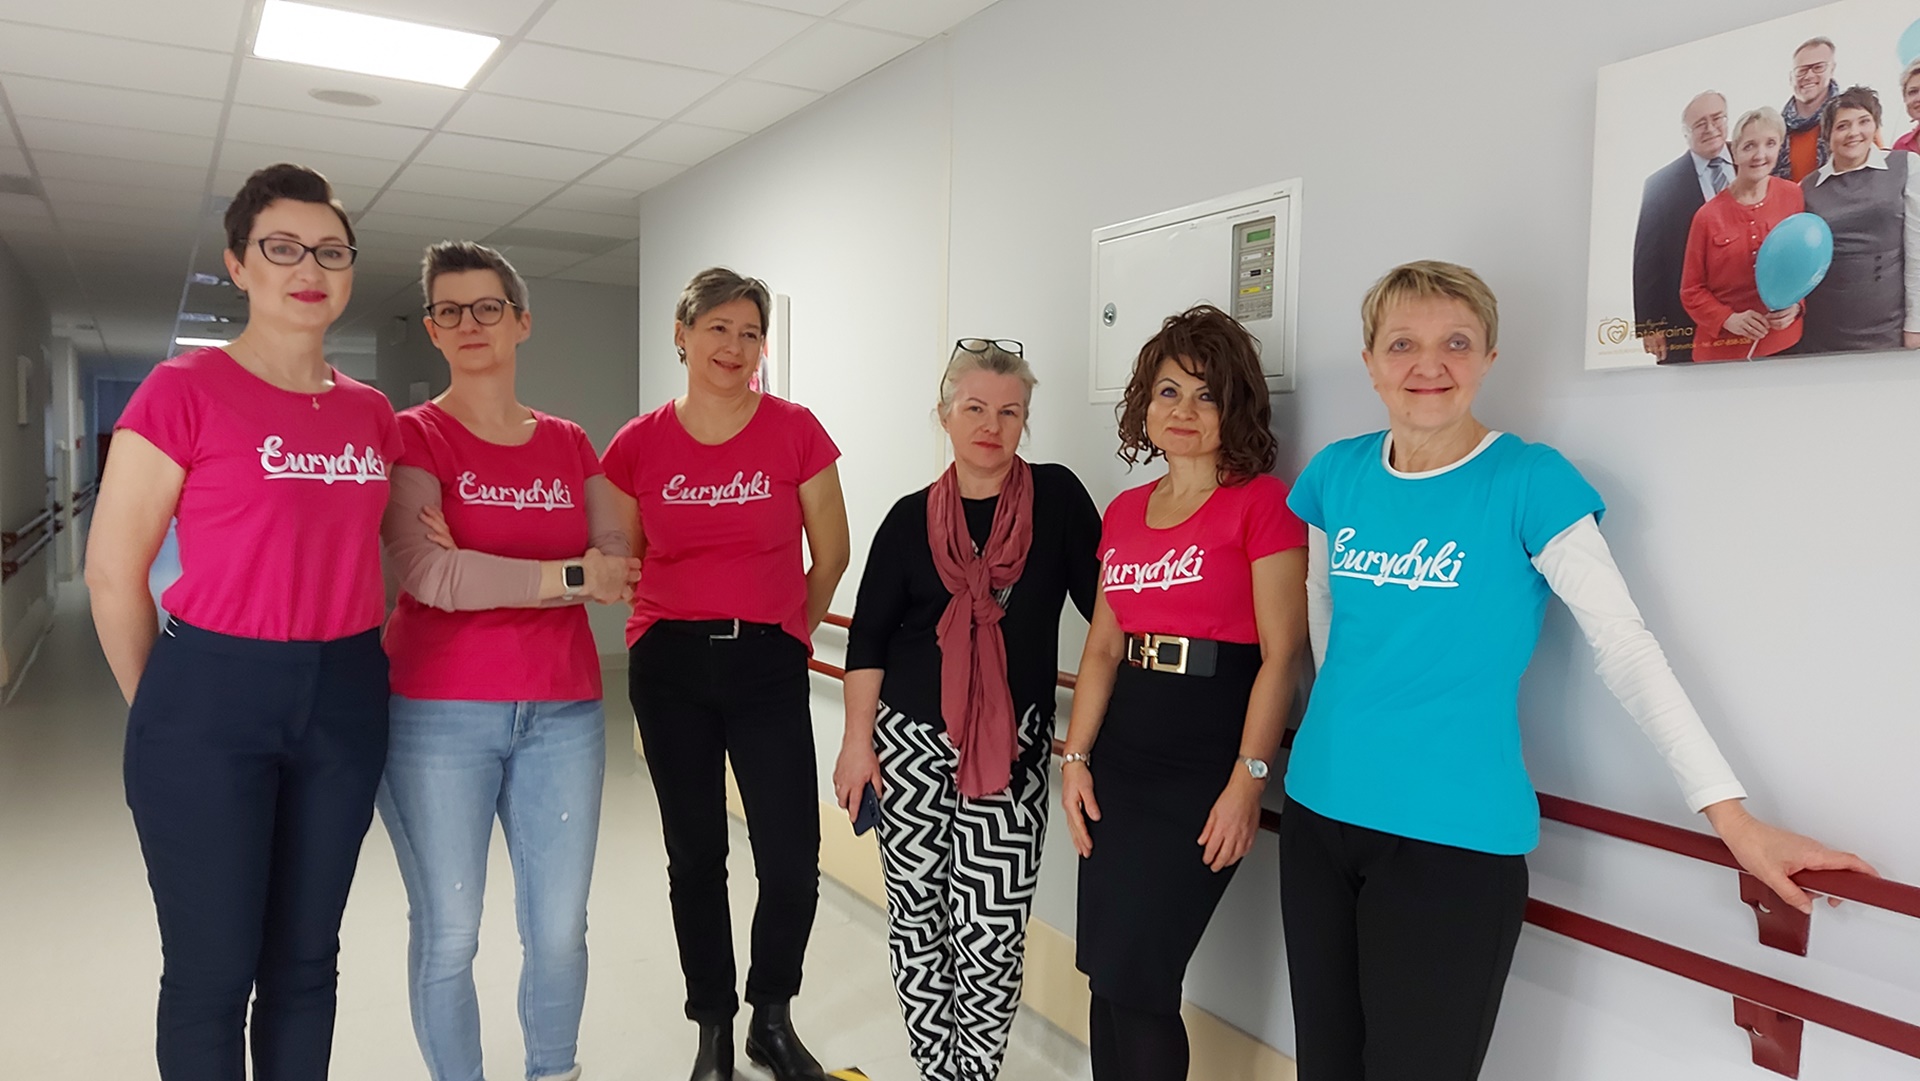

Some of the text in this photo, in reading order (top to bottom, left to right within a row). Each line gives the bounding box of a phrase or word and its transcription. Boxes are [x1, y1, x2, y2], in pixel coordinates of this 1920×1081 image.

[257, 435, 388, 484] Eurydyki
[457, 471, 574, 511] Eurydyki
[662, 471, 772, 507] Eurydyki
[1330, 527, 1466, 591] Eurydyki
